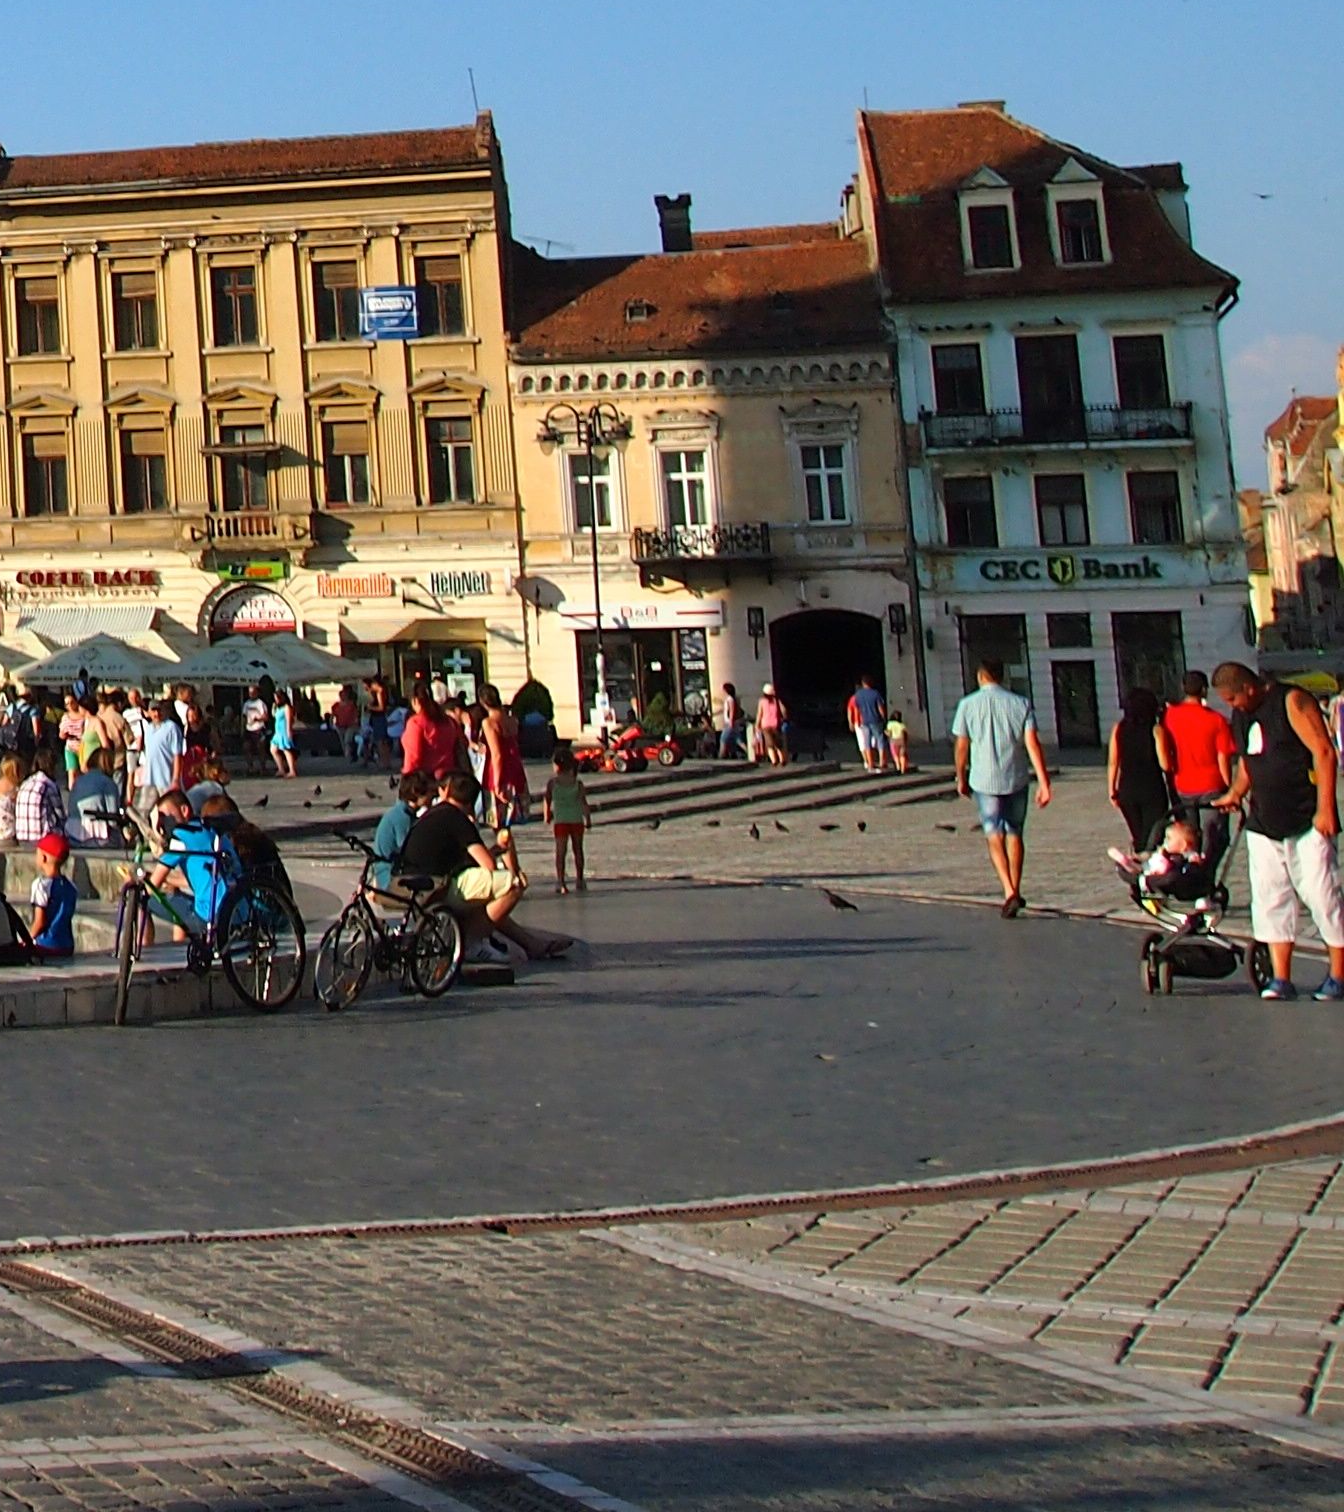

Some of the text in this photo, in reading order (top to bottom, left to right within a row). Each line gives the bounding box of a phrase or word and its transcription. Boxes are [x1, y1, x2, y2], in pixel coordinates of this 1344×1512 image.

[979, 554, 1163, 581] CEC Bank
[16, 569, 159, 586] COME BACK
[430, 570, 488, 598] HelpNet
[239, 599, 265, 609] ART
[219, 610, 286, 619] GALLERY
